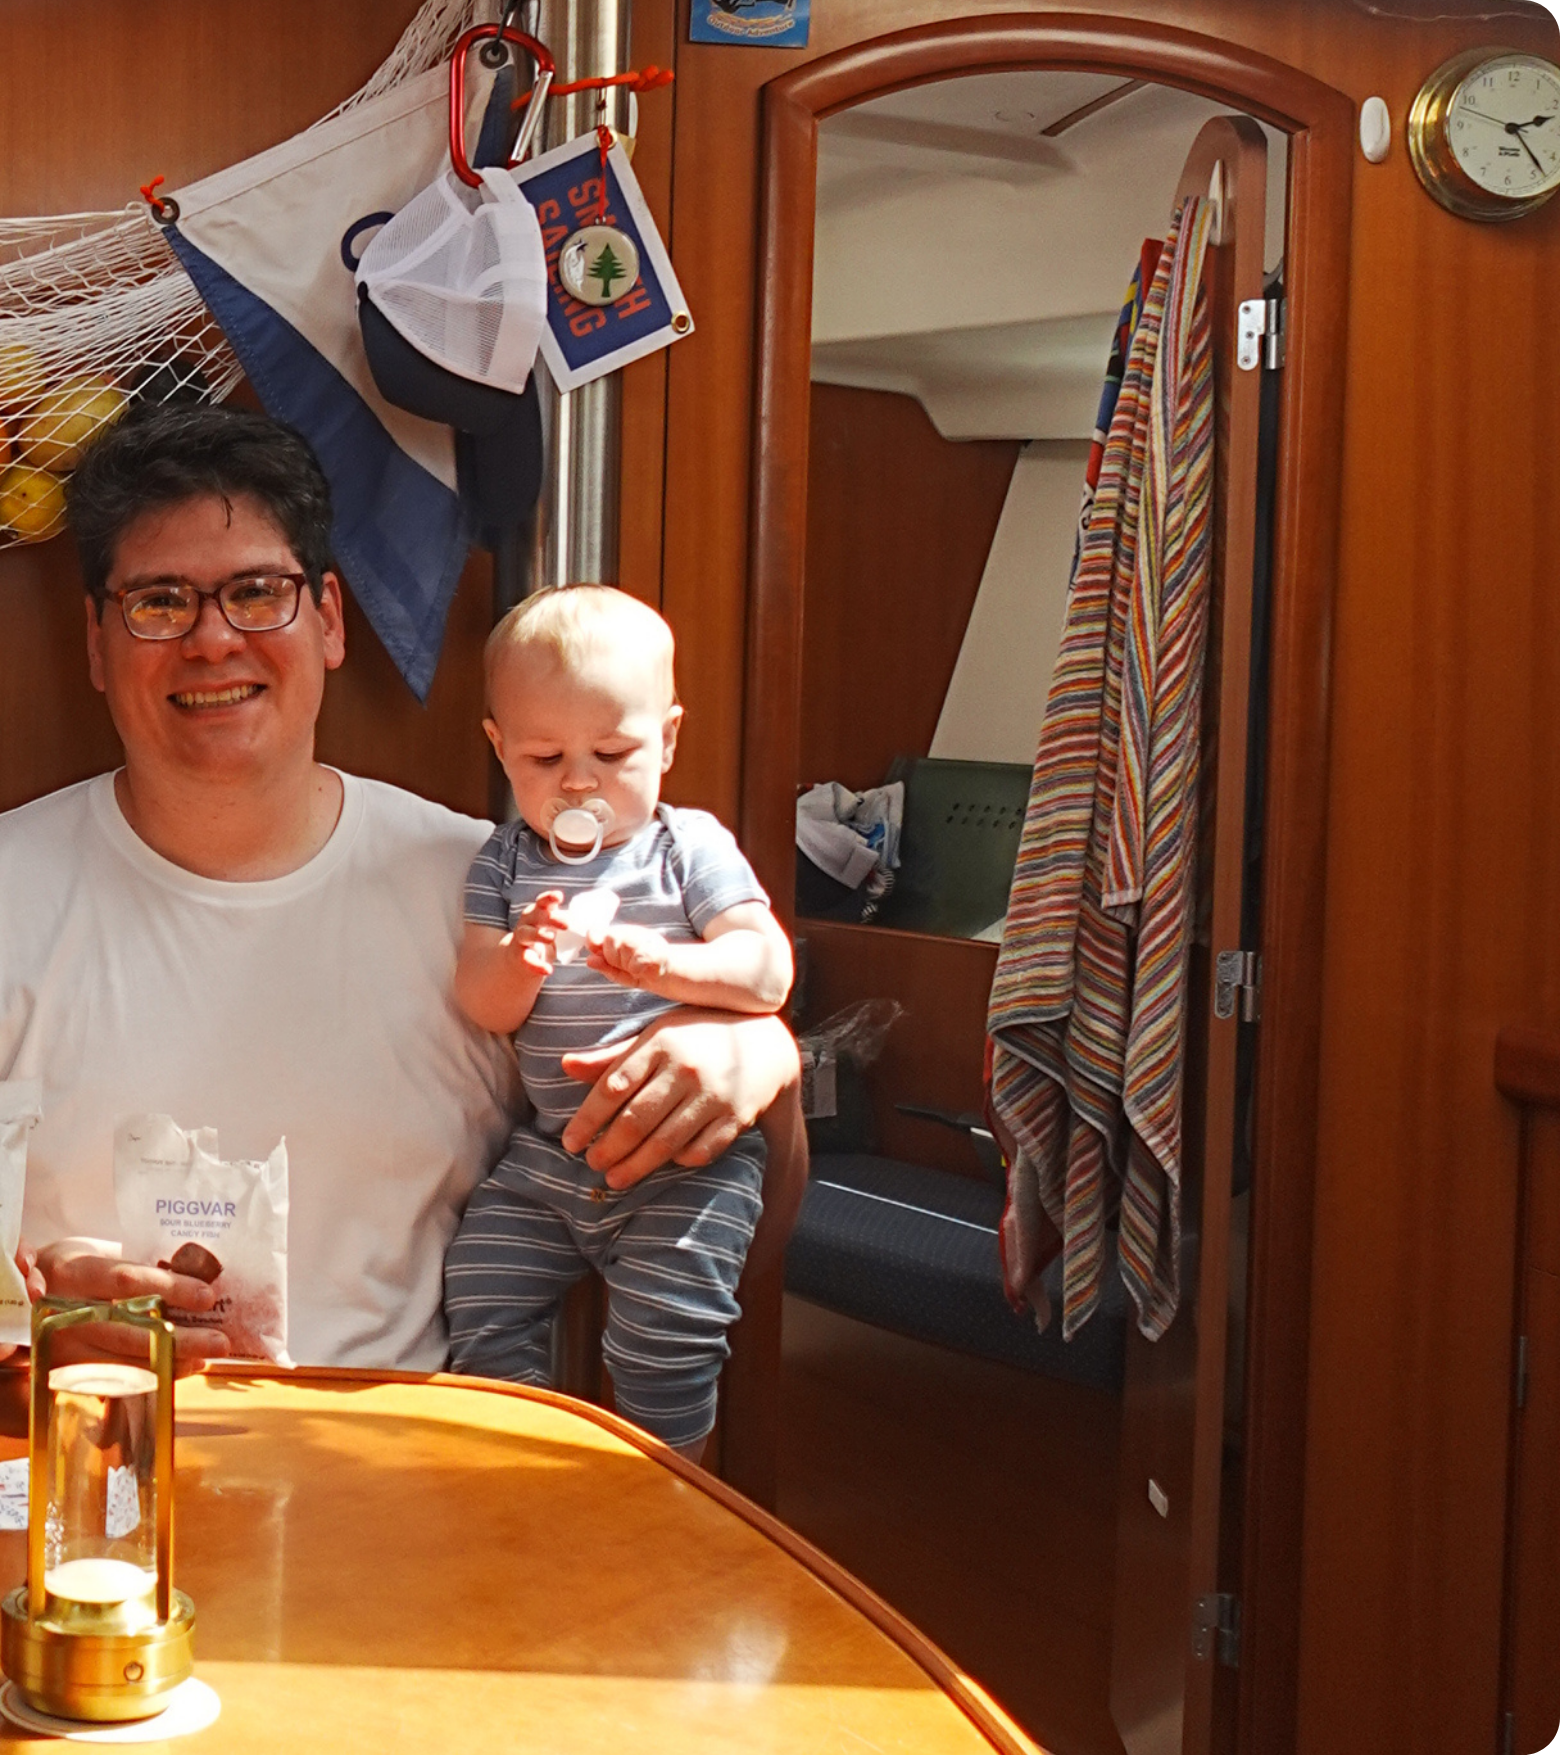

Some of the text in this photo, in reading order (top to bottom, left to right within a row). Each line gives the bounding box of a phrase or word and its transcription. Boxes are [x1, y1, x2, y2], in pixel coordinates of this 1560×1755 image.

[1508, 71, 1520, 81] 12
[1483, 77, 1493, 87] 11
[1463, 95, 1475, 105] 10
[1457, 121, 1464, 131] 9
[1462, 148, 1469, 157] 8
[1480, 166, 1487, 176] 7
[1530, 170, 1537, 179] 5
[1504, 176, 1512, 185] 6
[538, 199, 607, 337] SALNG
[156, 1199, 236, 1217] PIGGVAR
[160, 1218, 231, 1229] SOUR BLUEBERRY
[170, 1229, 199, 1237] CANDY
